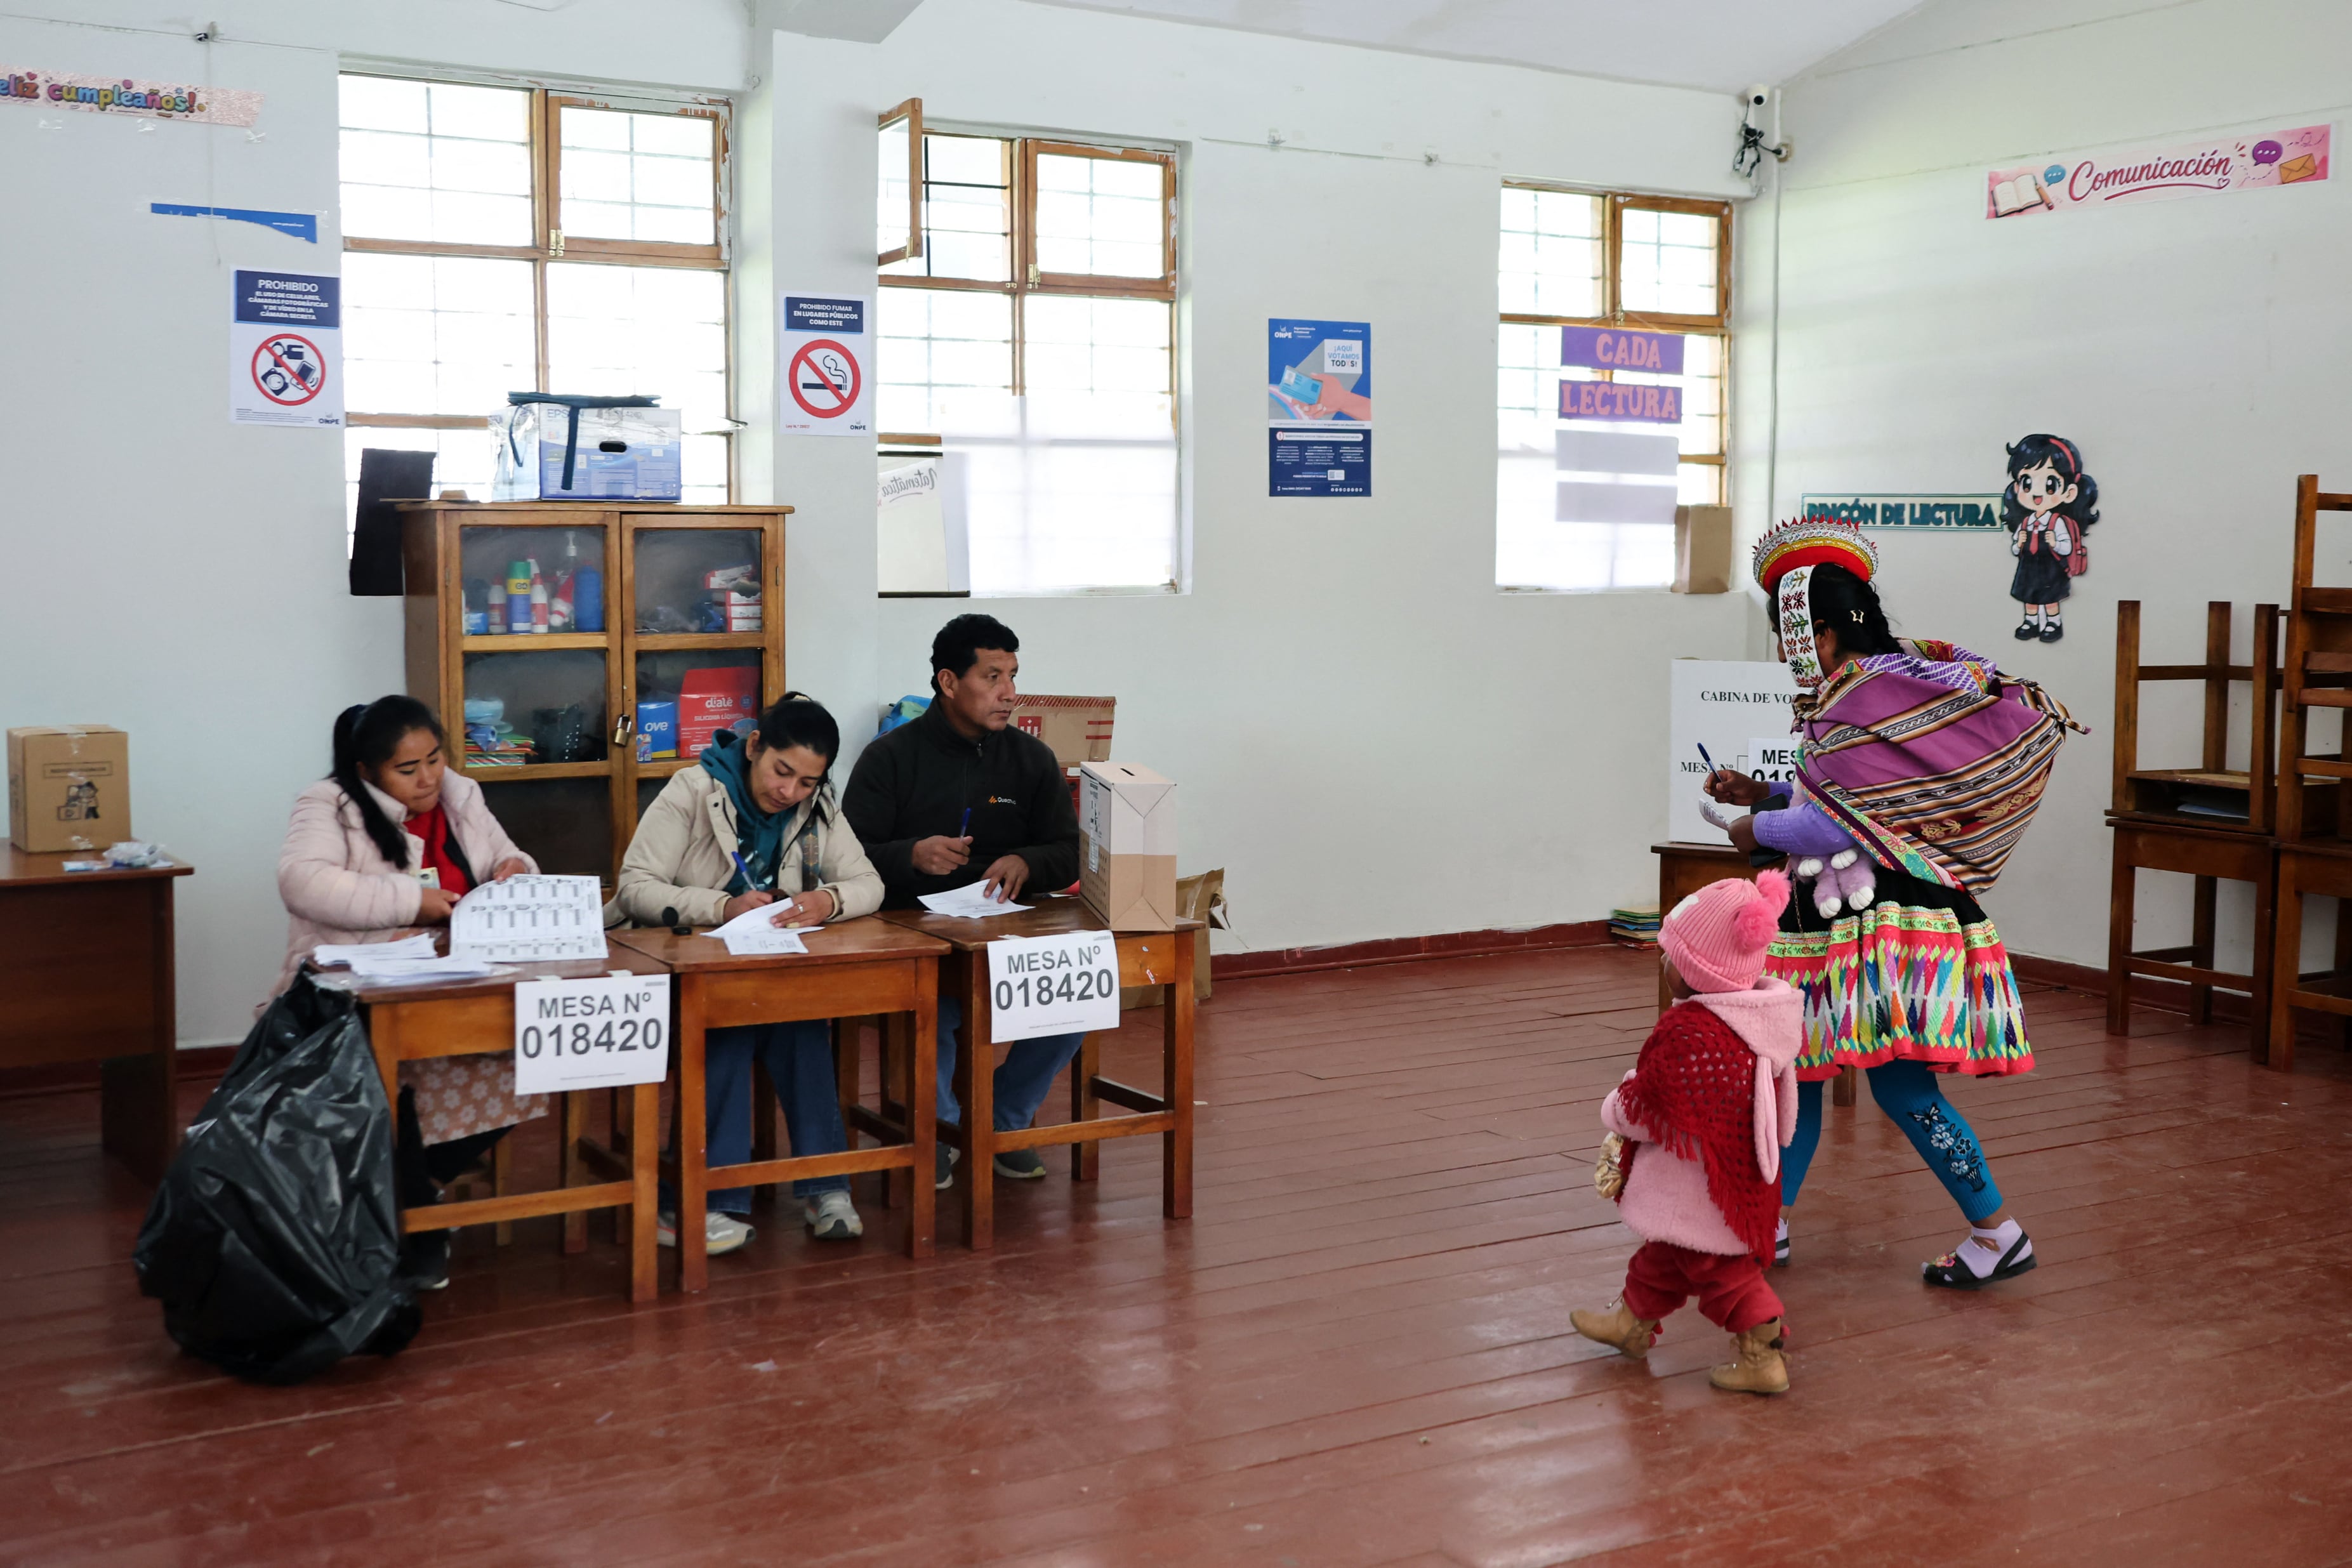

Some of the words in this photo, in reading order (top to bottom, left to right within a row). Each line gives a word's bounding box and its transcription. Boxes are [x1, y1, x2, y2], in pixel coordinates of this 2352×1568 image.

[0, 74, 39, 99] eliz
[48, 84, 196, 113] cumpleaños!
[2068, 149, 2233, 201] Comunicación
[258, 279, 319, 292] PROHIBIDO
[1596, 333, 1662, 369] CADA
[1561, 383, 1677, 419] LECTURA
[547, 409, 584, 419] EPSN
[1880, 503, 1906, 525] DE
[1909, 503, 1997, 526] LECTURA
[1701, 690, 1750, 702] CABINA
[1753, 692, 1771, 703] DE
[1773, 694, 1797, 704] VO
[645, 721, 668, 732] ove
[1681, 761, 1712, 773] MES
[1762, 749, 1796, 765] MES
[1007, 949, 1073, 974] MESA
[995, 968, 1114, 1010] 018420
[539, 994, 615, 1018] MESA
[522, 1018, 662, 1058] 018420
